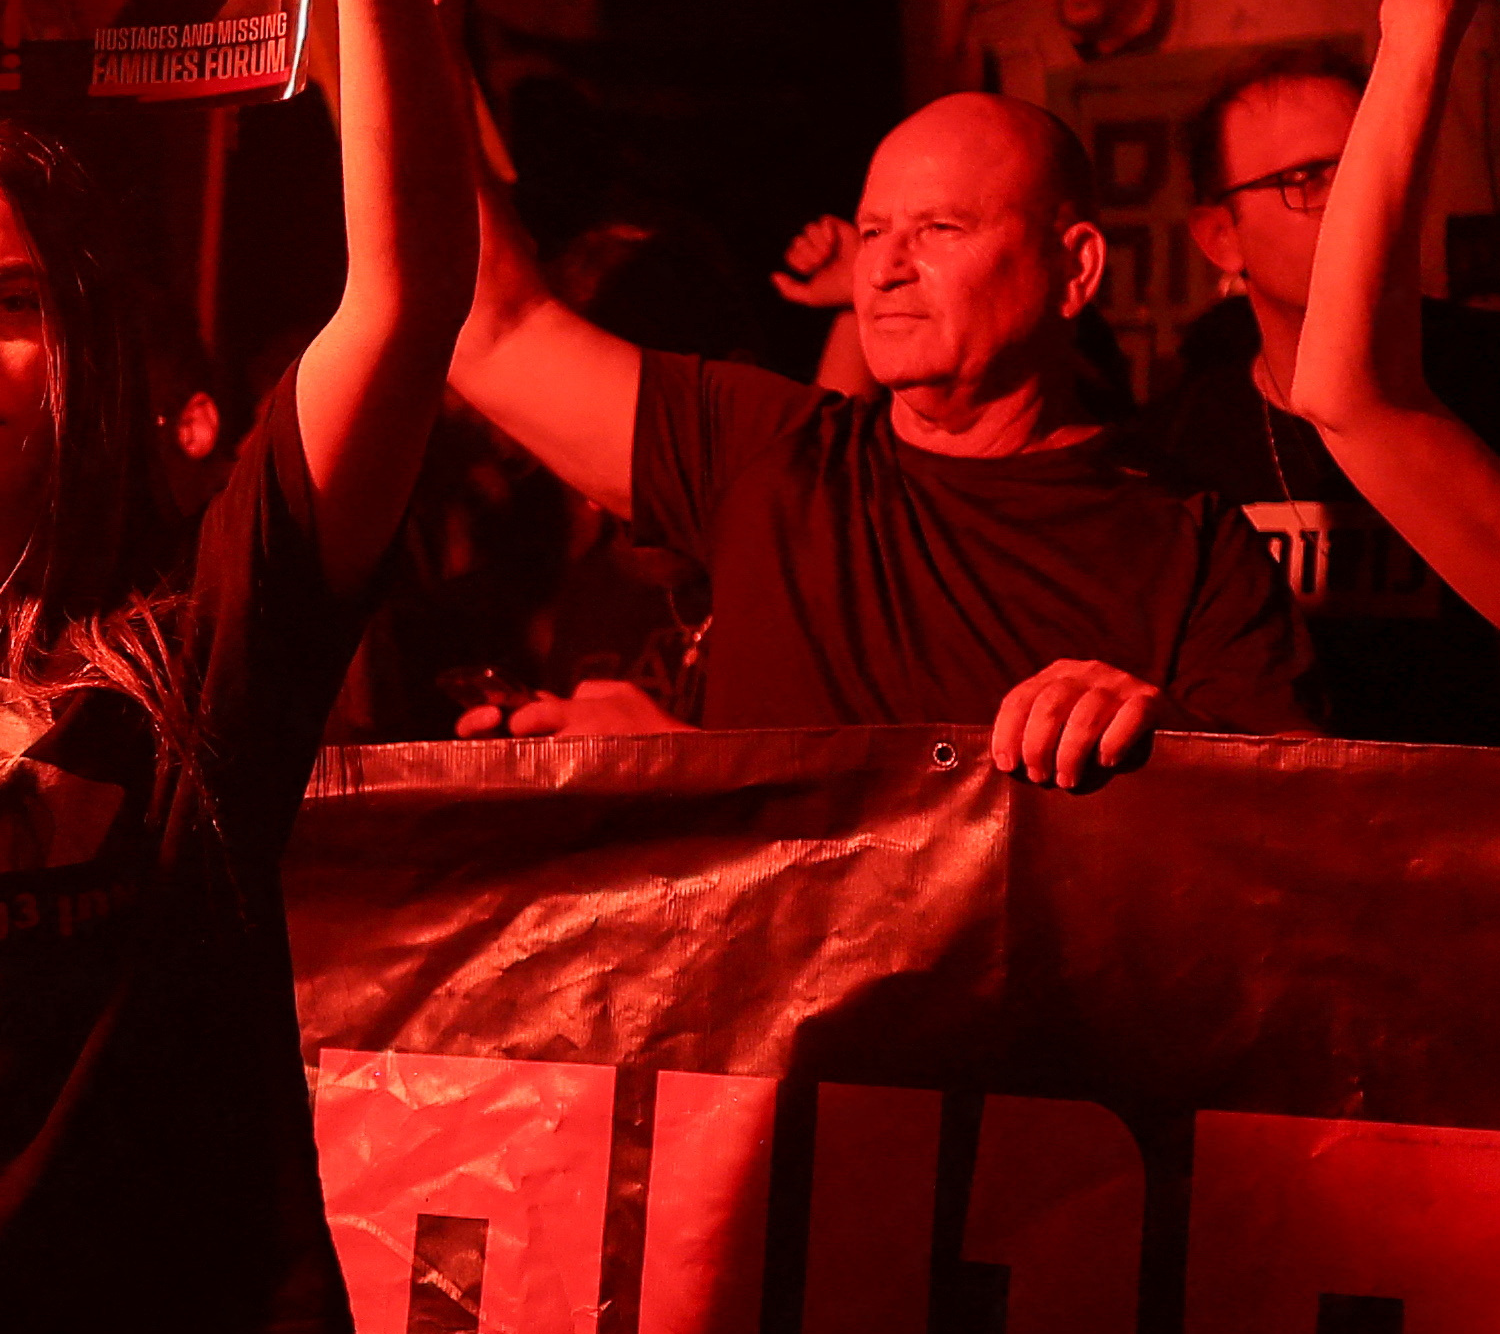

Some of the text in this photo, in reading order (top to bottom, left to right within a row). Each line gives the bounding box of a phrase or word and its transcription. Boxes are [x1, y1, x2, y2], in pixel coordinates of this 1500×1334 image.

[94, 11, 289, 51] HOSTAGES AND MISSING
[91, 37, 287, 85] FAMILIES FORUM
